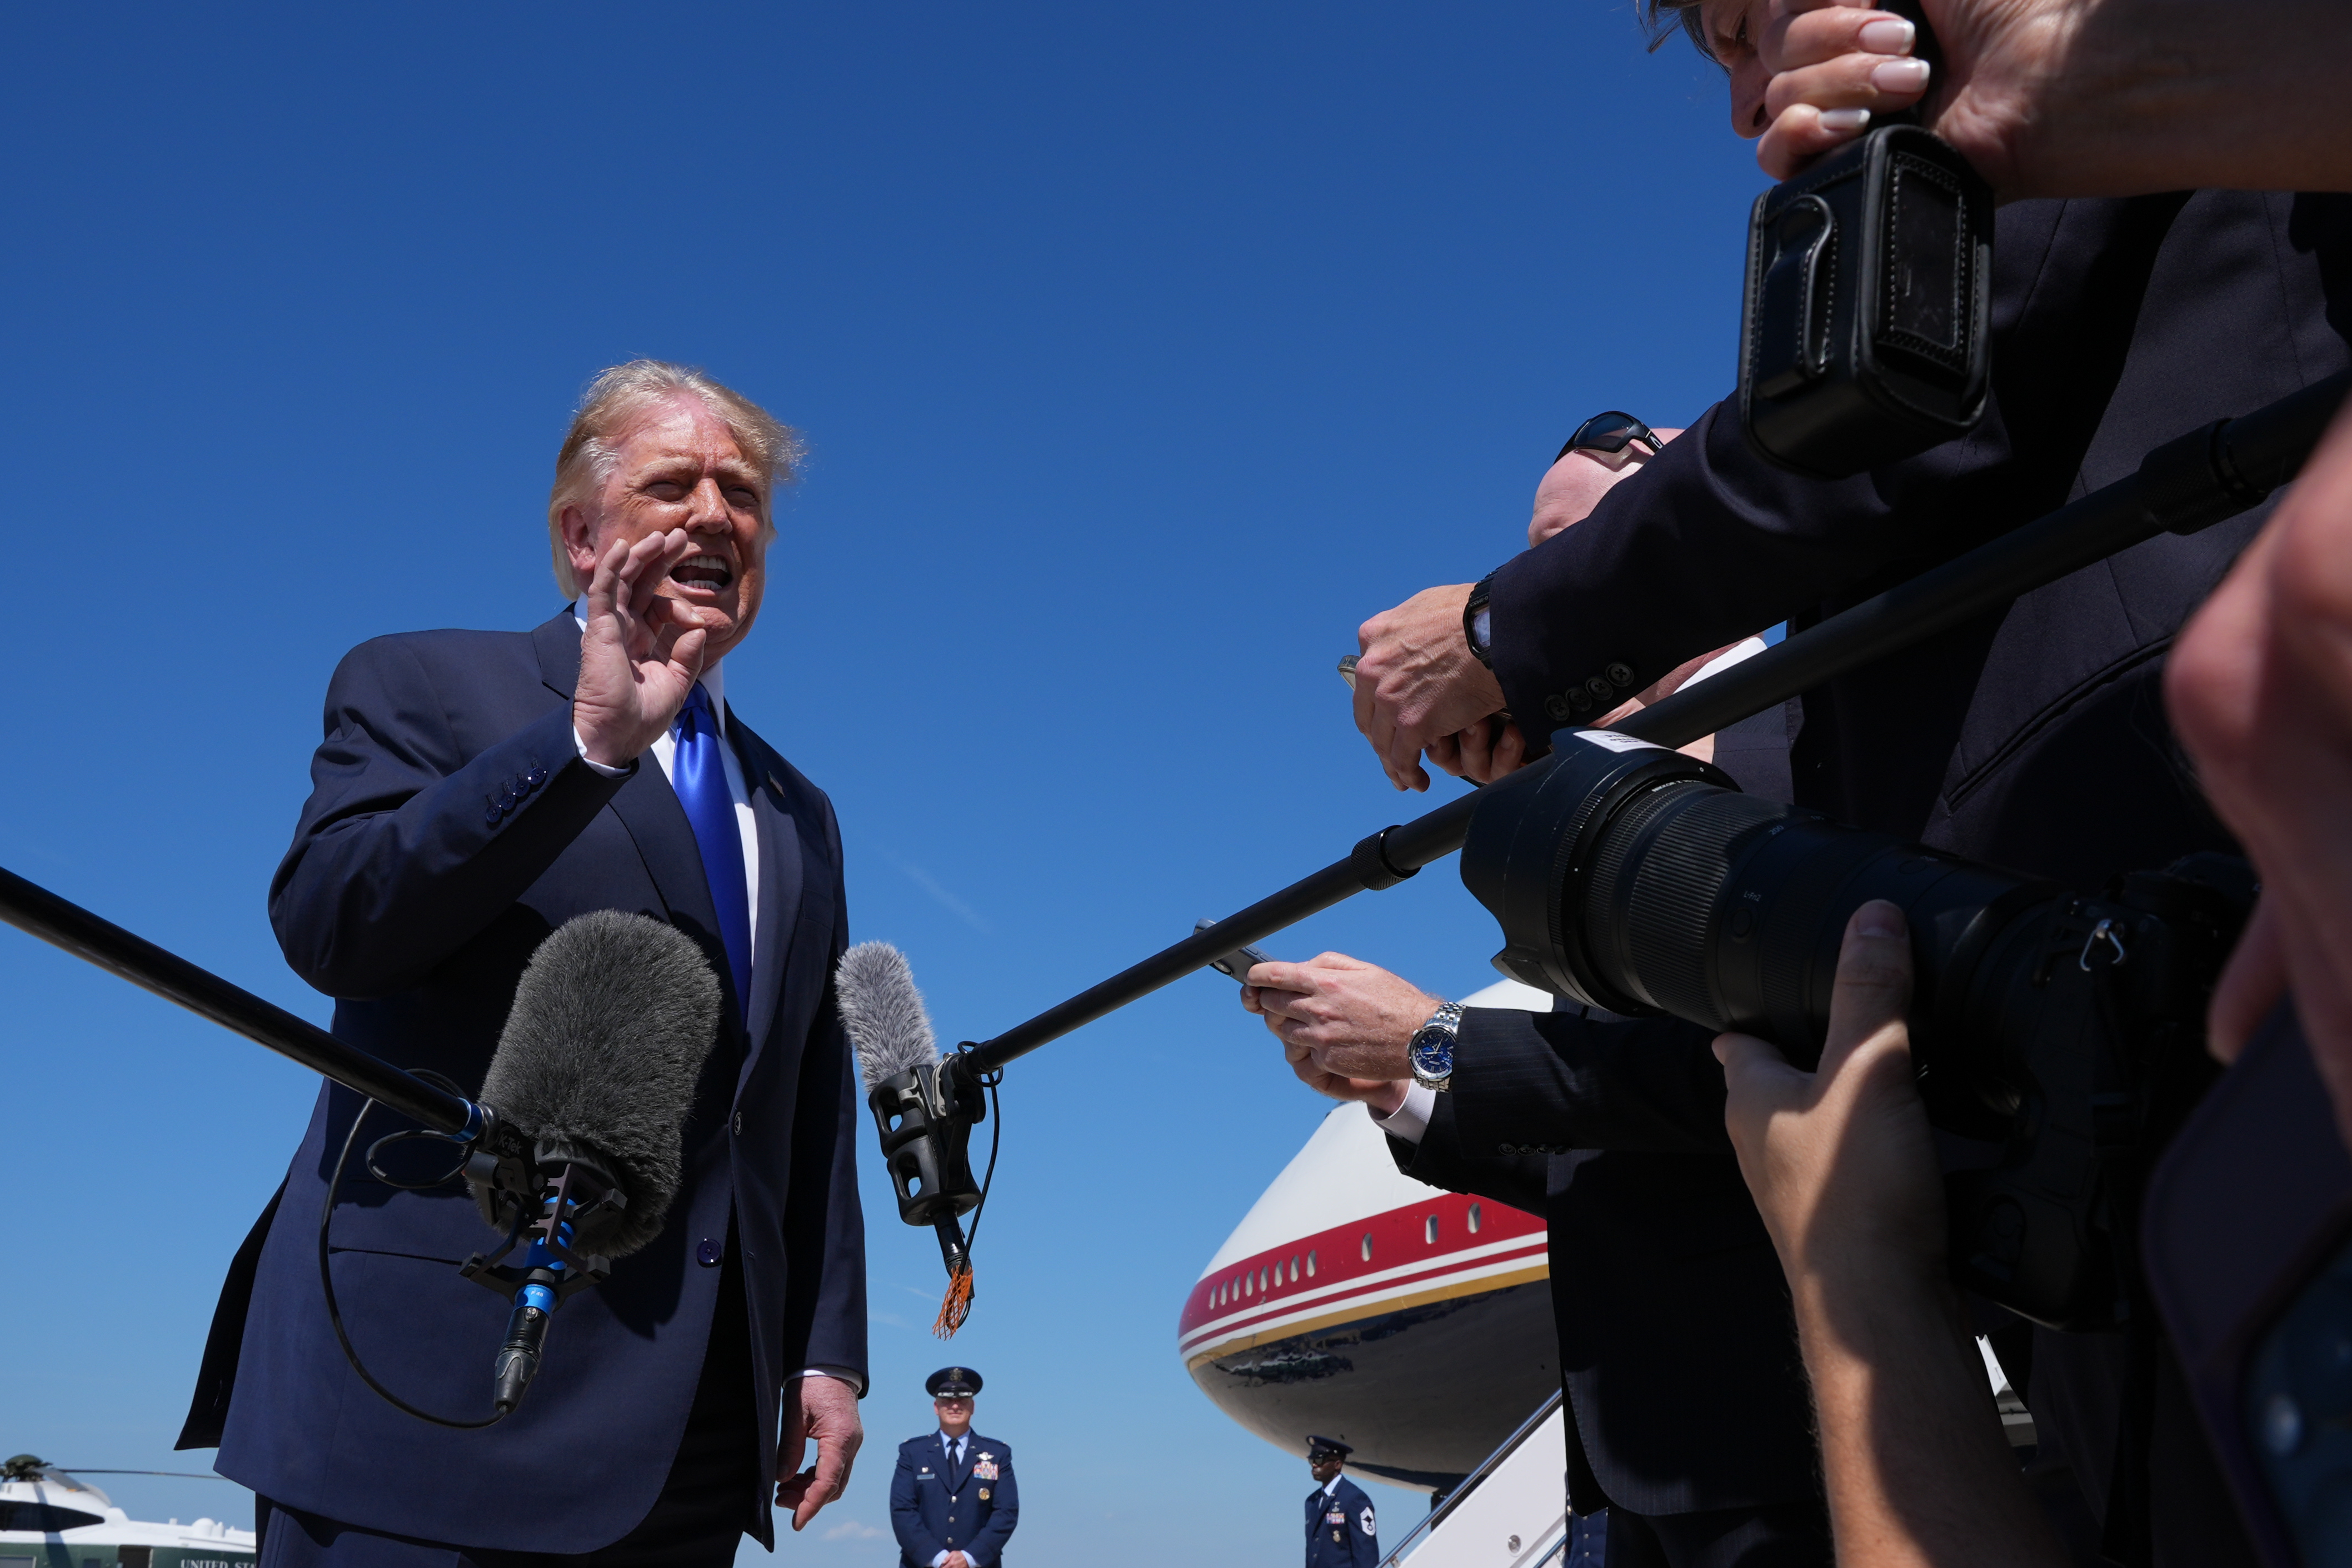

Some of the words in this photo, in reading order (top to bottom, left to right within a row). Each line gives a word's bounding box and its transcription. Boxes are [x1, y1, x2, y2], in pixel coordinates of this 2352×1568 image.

[1768, 825, 1784, 835] 200
[1744, 890, 1761, 902] L-Fn2
[181, 1559, 228, 1568] UNITED
